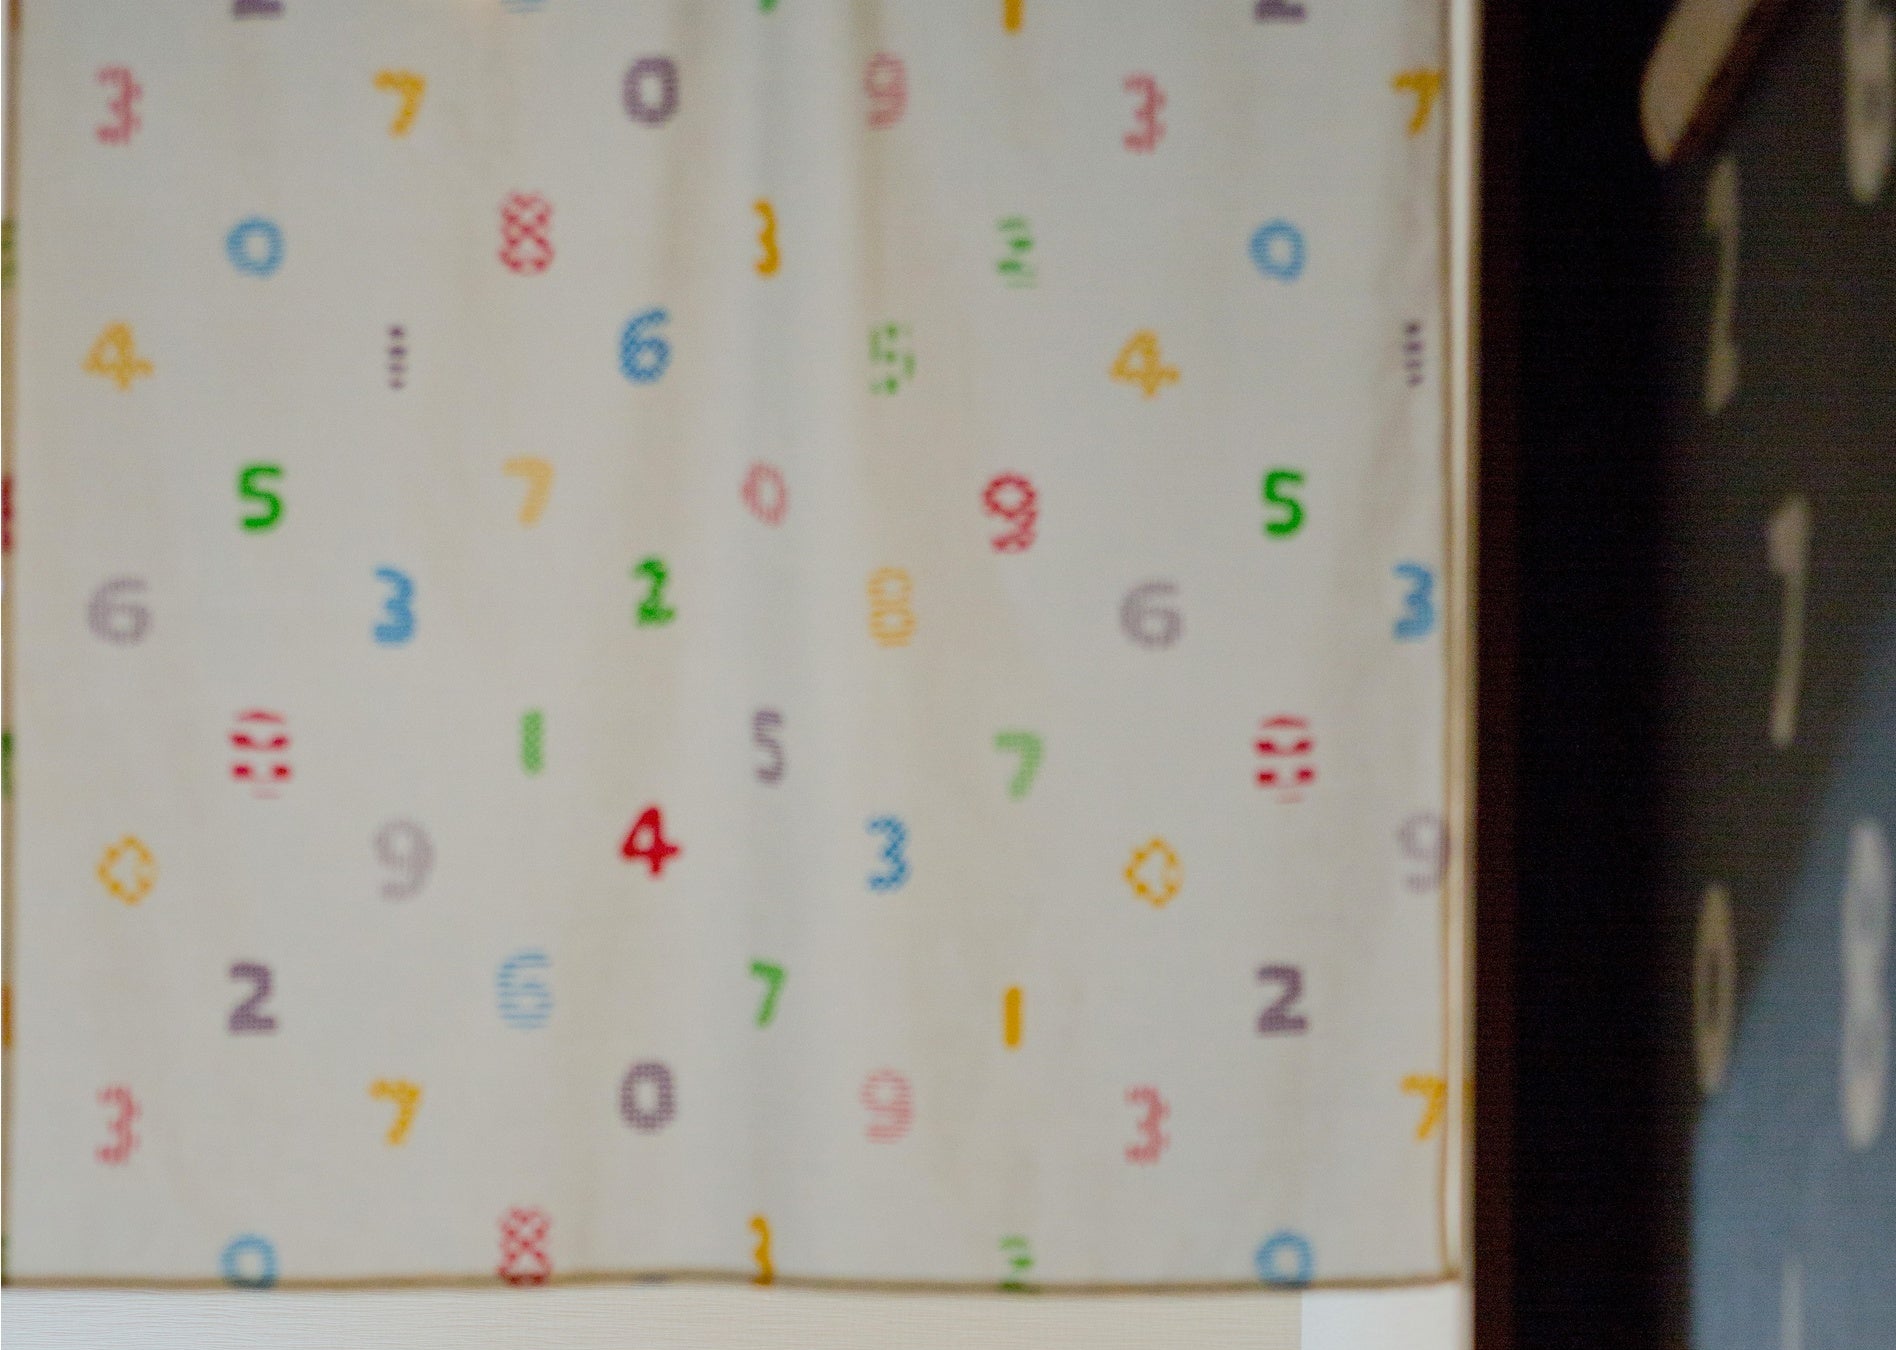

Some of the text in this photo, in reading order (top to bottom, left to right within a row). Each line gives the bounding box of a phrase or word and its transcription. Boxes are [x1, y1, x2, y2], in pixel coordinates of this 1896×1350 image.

[95, 65, 143, 145] 3
[373, 69, 427, 137] 7
[622, 54, 682, 128] 0
[860, 52, 909, 133] 9
[1123, 73, 1167, 153] 3
[1392, 69, 1441, 138] 7
[224, 215, 285, 278] 0
[497, 192, 555, 274] 8
[752, 198, 782, 278] 3
[81, 321, 154, 391] 4
[618, 307, 672, 384] 6
[1109, 329, 1181, 399] 4
[236, 462, 285, 534] 5
[502, 454, 555, 527] 7
[739, 460, 790, 527] 0
[980, 472, 1039, 553] 9
[1261, 468, 1307, 539] 5
[84, 575, 154, 646] 6
[372, 565, 417, 646] 3
[634, 557, 676, 626] 2
[866, 565, 919, 648] 8
[1118, 578, 1185, 650] 6
[1392, 561, 1437, 641] 3
[751, 707, 787, 787] 5
[993, 729, 1045, 801] 7
[371, 818, 437, 903] 9
[619, 805, 681, 878] 4
[867, 815, 911, 892] 3
[1398, 812, 1450, 894] 9
[227, 960, 278, 1035] 2
[494, 947, 555, 1030] 6
[748, 959, 787, 1028] 7
[1256, 963, 1310, 1036] 2
[1842, 825, 1892, 1151] 8
[94, 1085, 142, 1166] 3
[369, 1079, 422, 1146] 7
[618, 1060, 677, 1134] 0
[860, 1068, 917, 1144] 9
[1124, 1085, 1171, 1166] 3
[1401, 1074, 1447, 1143] 7
[498, 1205, 552, 1286] 8
